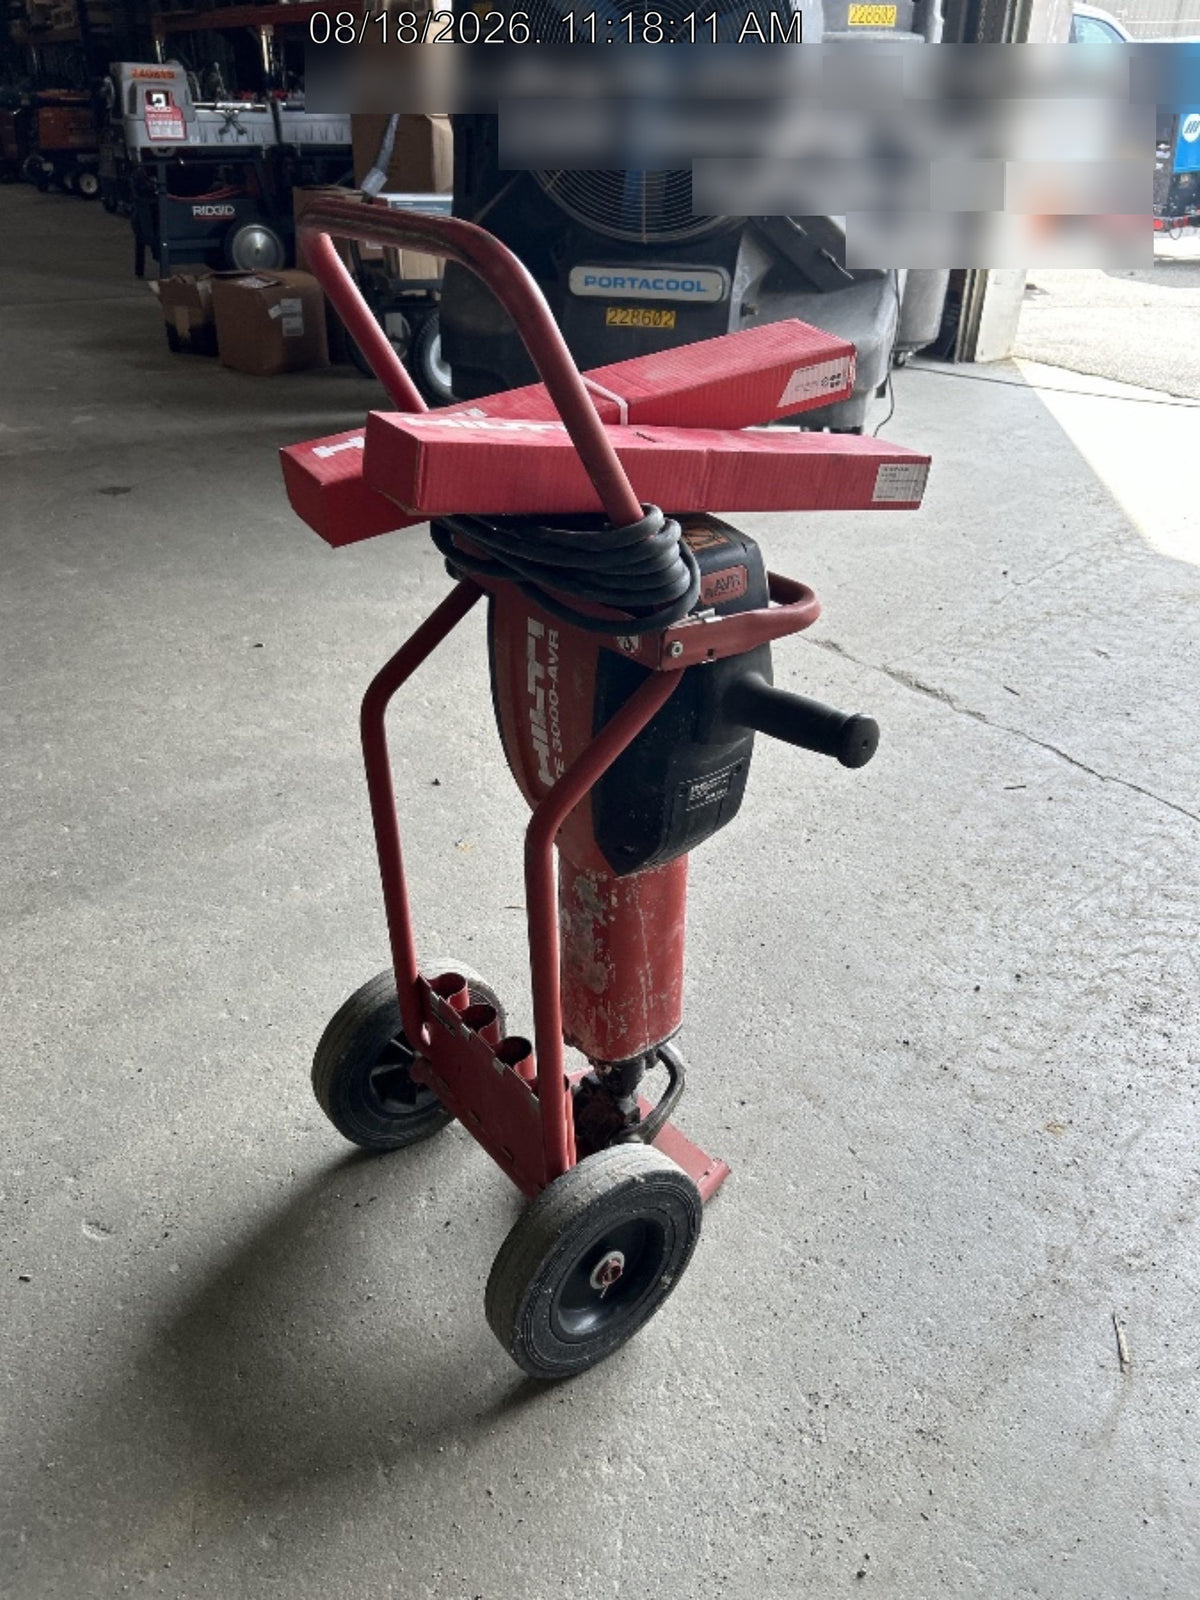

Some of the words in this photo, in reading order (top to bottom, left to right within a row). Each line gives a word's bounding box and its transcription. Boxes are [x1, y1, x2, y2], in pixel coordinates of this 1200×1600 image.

[192, 204, 236, 216] RIDGID
[584, 275, 707, 293] PORTACOOL
[607, 308, 674, 327] 228602
[547, 629, 562, 753] 3000-AVR
[528, 616, 555, 787] HILTI
